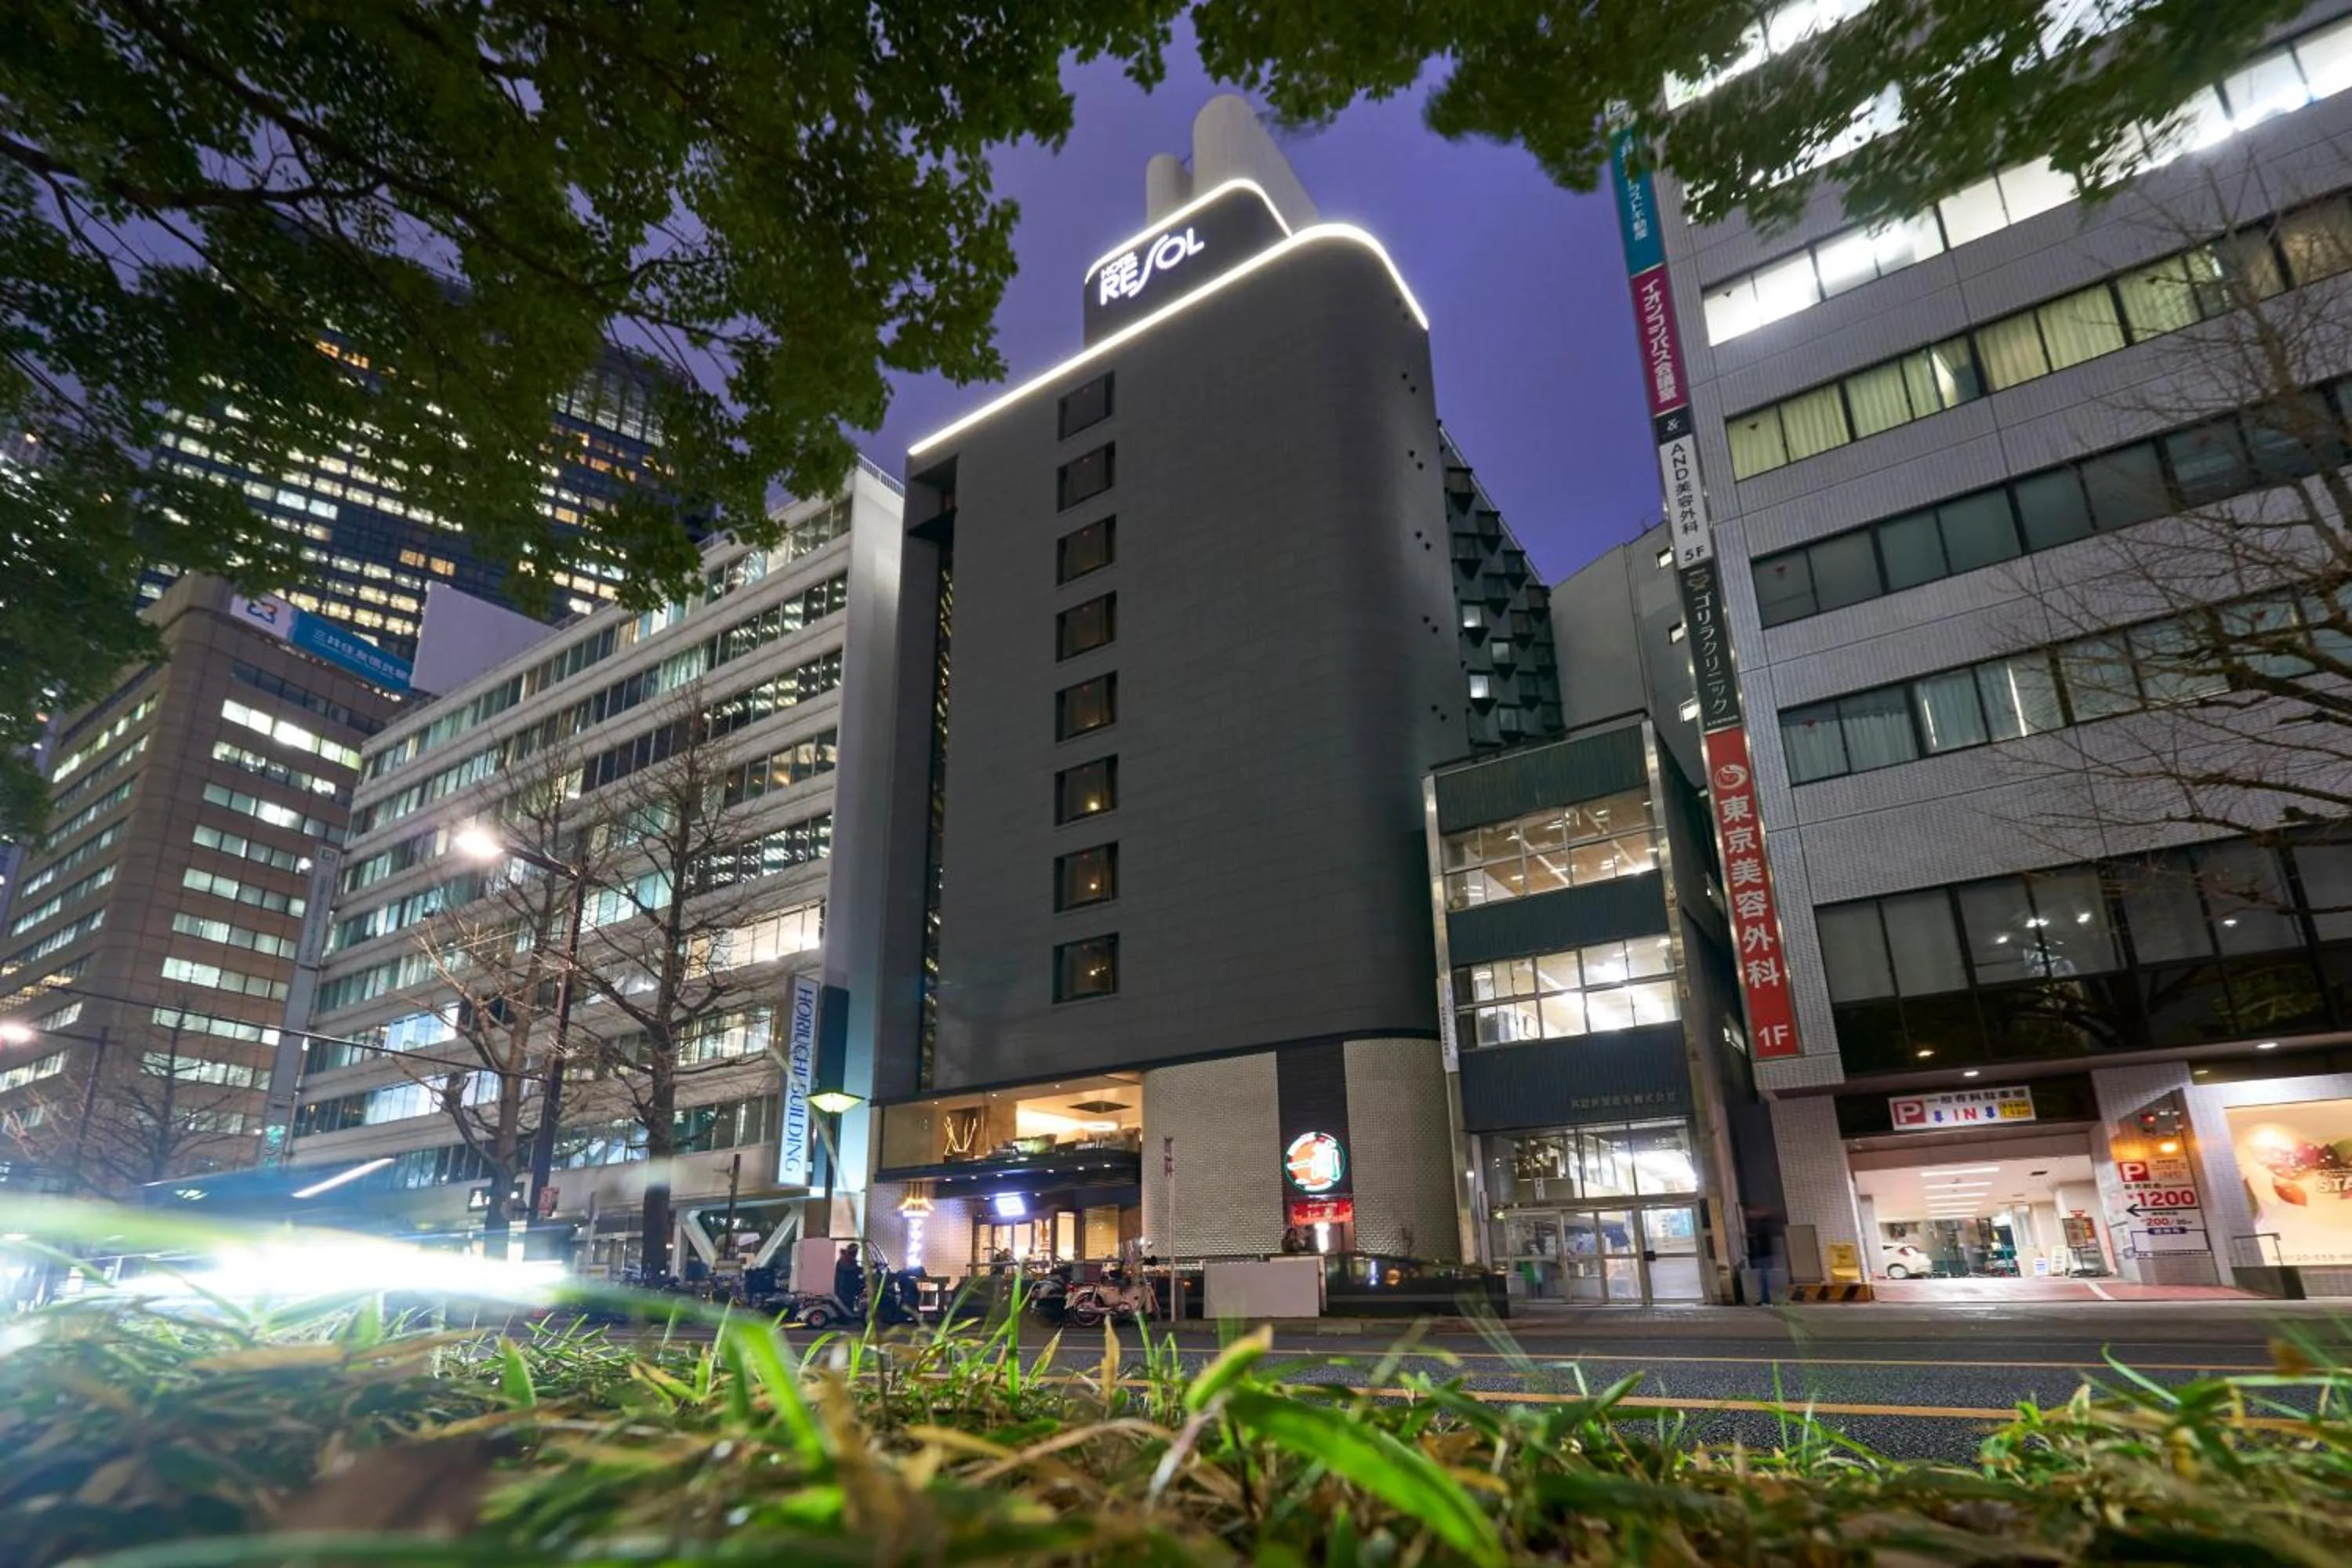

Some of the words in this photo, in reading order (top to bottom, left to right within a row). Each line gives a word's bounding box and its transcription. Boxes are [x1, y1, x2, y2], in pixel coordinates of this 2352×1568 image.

[1100, 227, 1205, 306] RESOL
[1671, 443, 1698, 535] AND美容外科
[1683, 545, 1705, 561] 5F
[1693, 590, 1727, 715] ゴリラクリニック
[1719, 793, 1780, 989] 東京美容外科
[1757, 1023, 1790, 1047] 1F
[1896, 1101, 1922, 1123] P
[1952, 1107, 1977, 1121] IN
[2122, 1163, 2146, 1181] P
